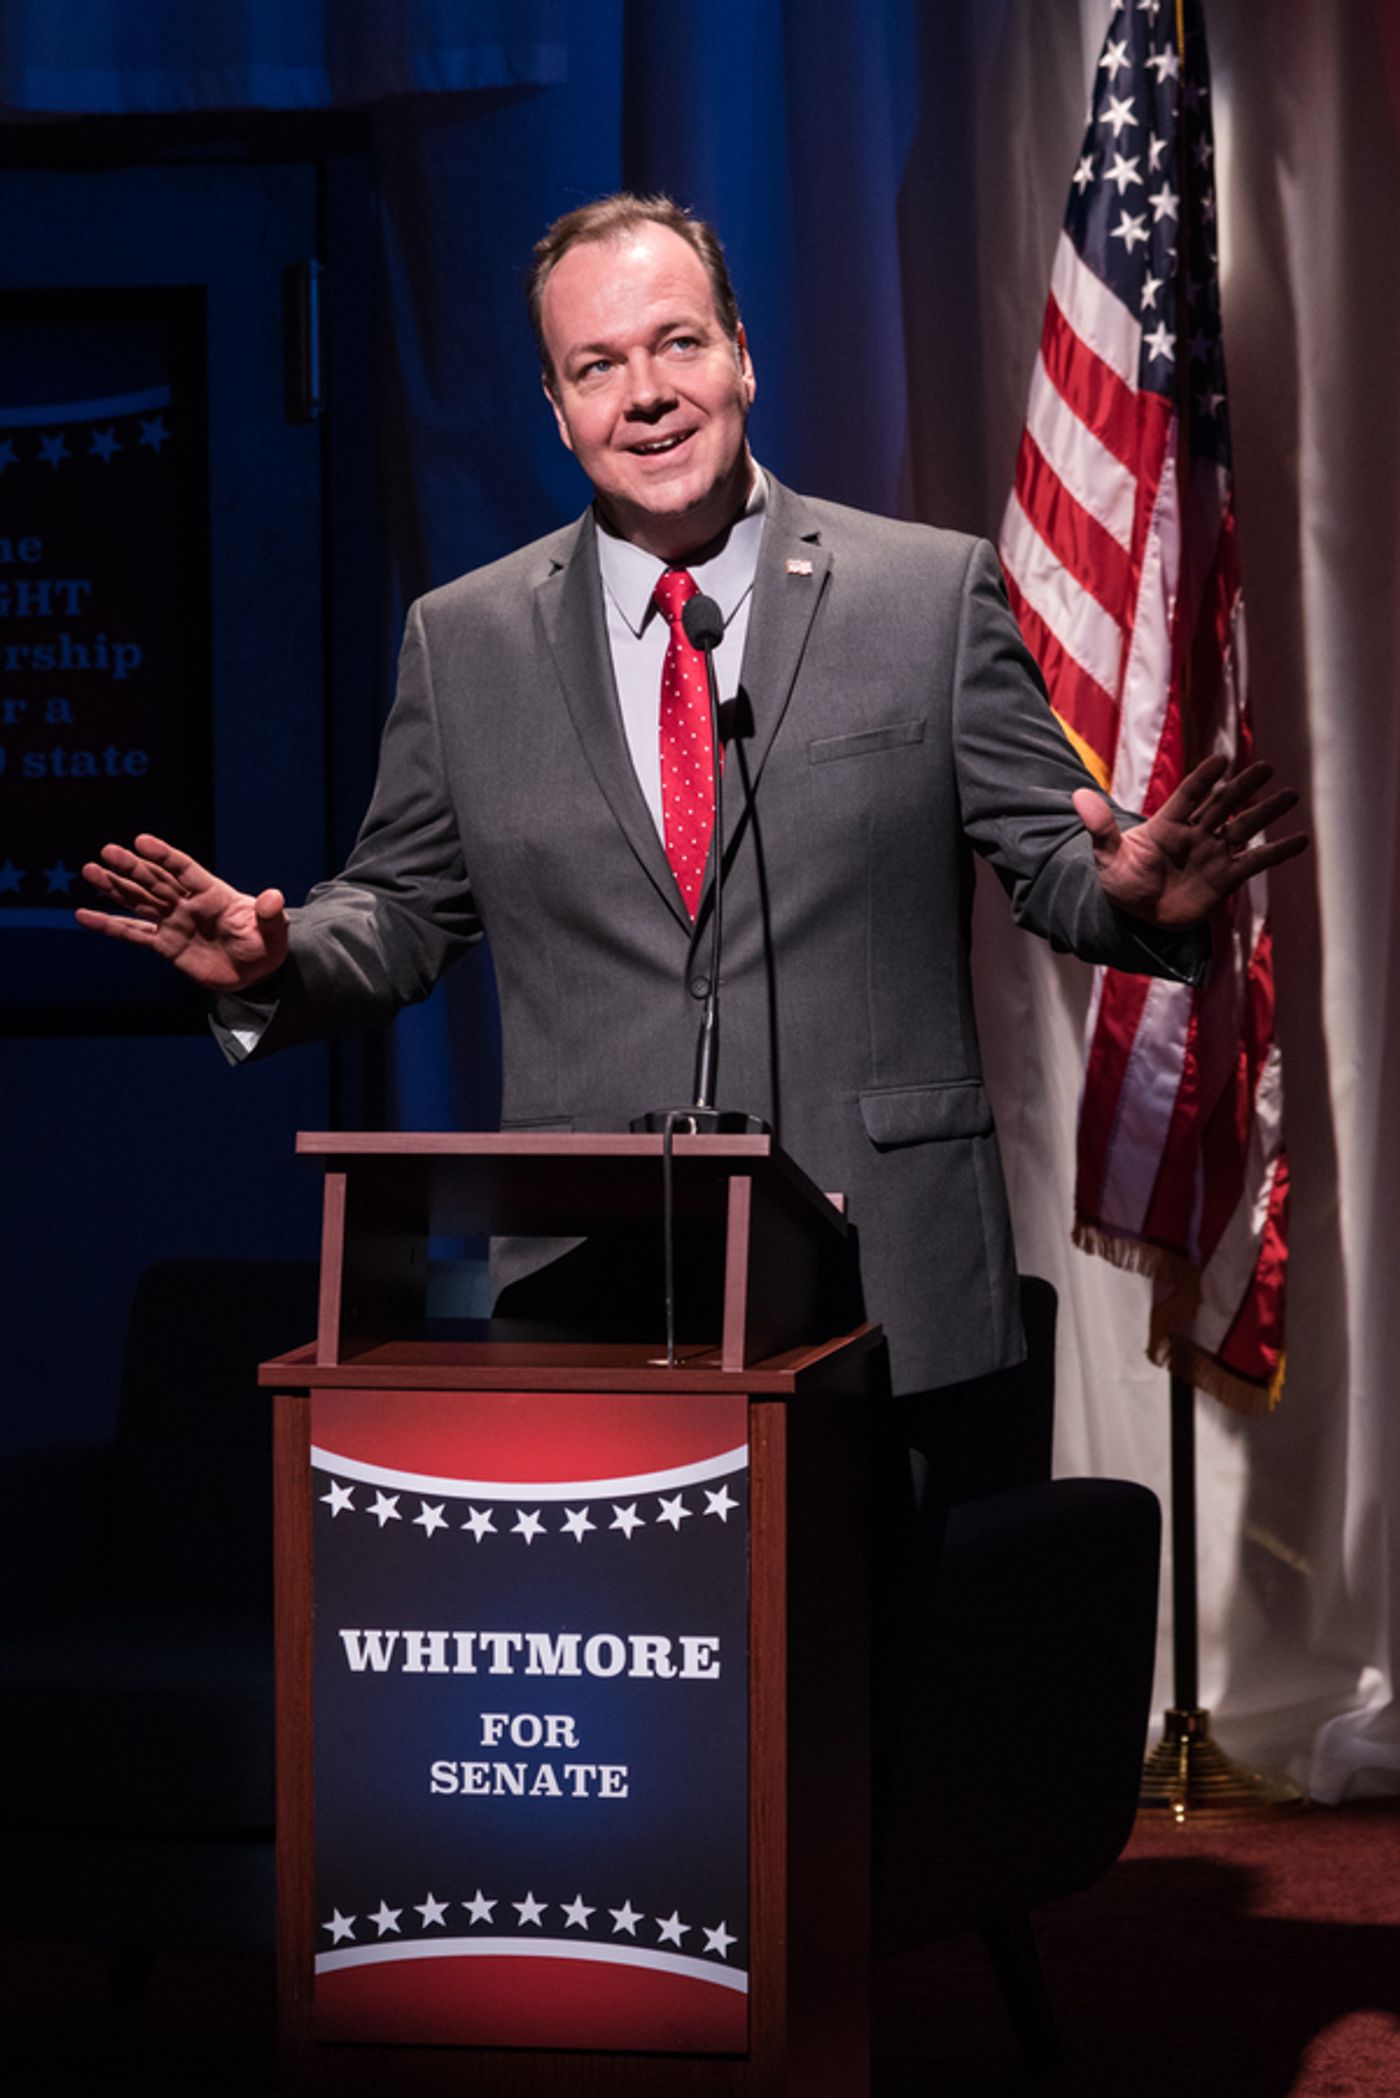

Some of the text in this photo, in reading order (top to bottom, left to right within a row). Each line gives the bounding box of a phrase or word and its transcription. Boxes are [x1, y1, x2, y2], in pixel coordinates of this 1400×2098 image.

[45, 698, 73, 724] a
[23, 745, 149, 777] state
[338, 1628, 721, 1680] WHITMORE
[479, 1712, 580, 1749] FOR
[430, 1760, 630, 1799] SENATE
